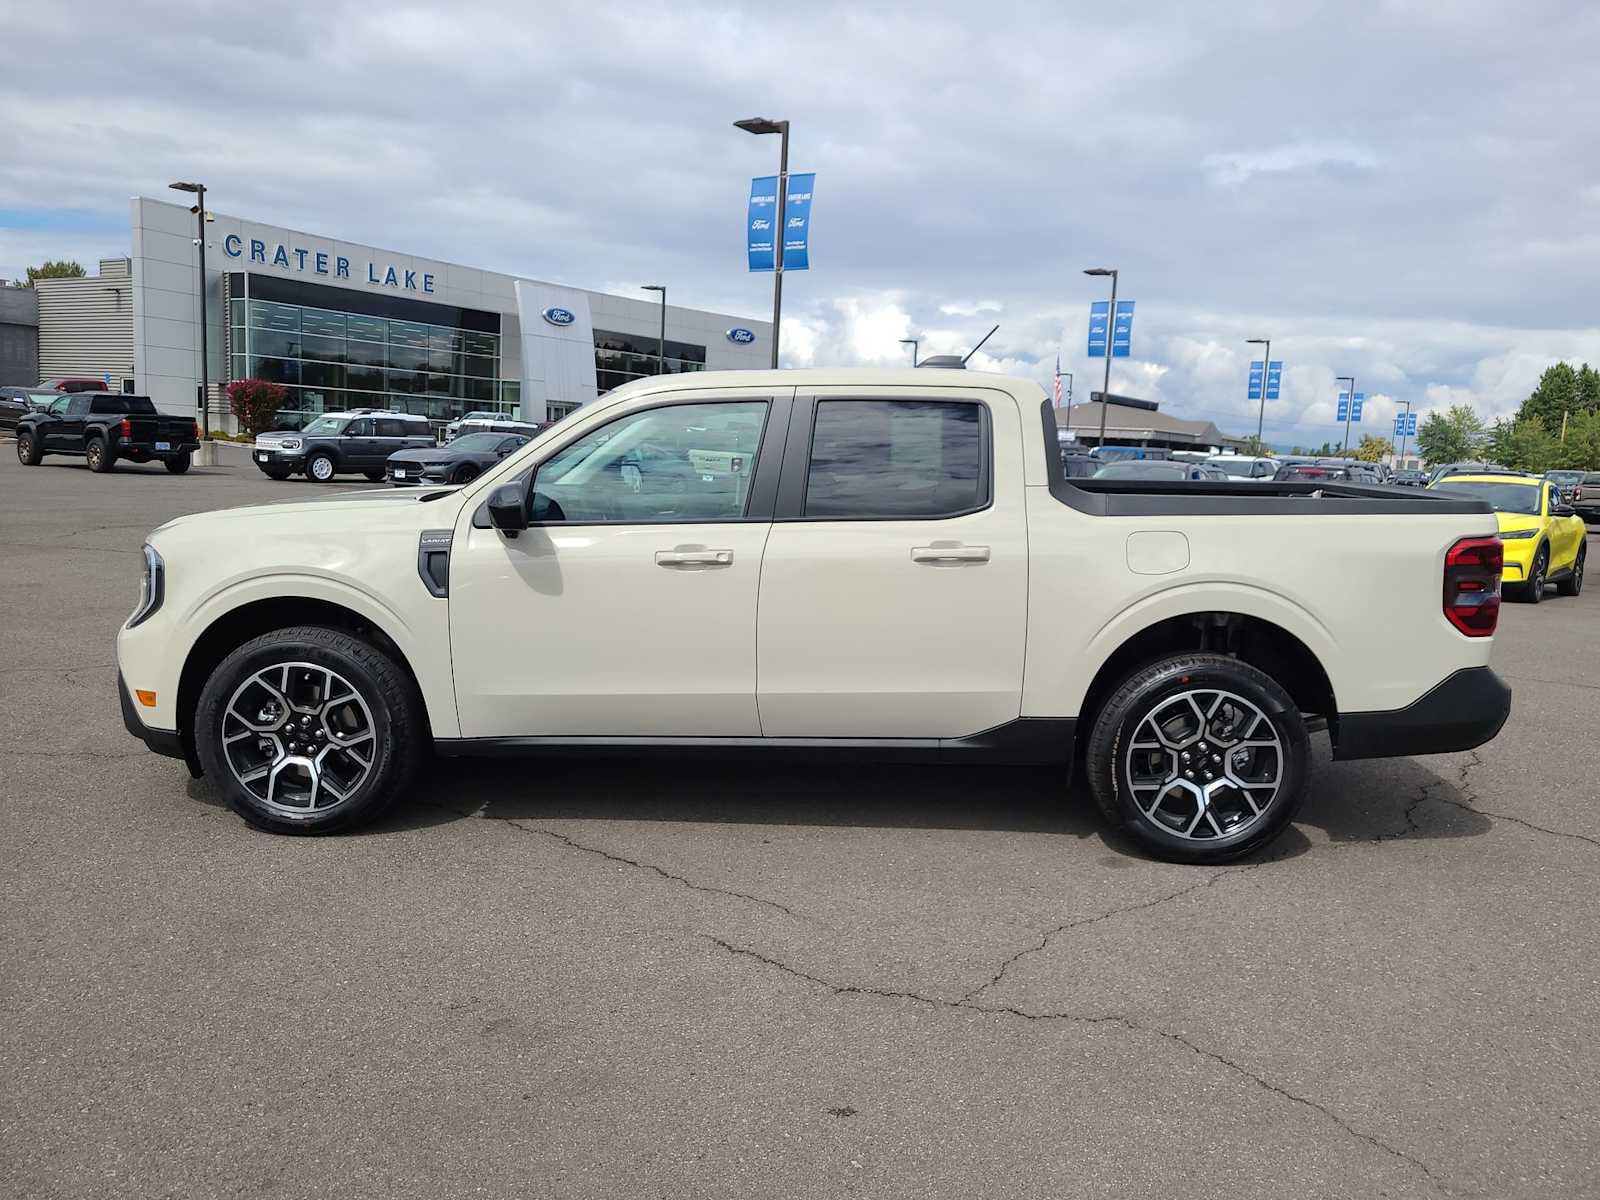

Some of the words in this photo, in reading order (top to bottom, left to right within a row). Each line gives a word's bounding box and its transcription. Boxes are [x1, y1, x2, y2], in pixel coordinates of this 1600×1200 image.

[751, 219, 770, 230] Ford
[224, 234, 350, 279] CRATER
[367, 262, 434, 293] LAKE
